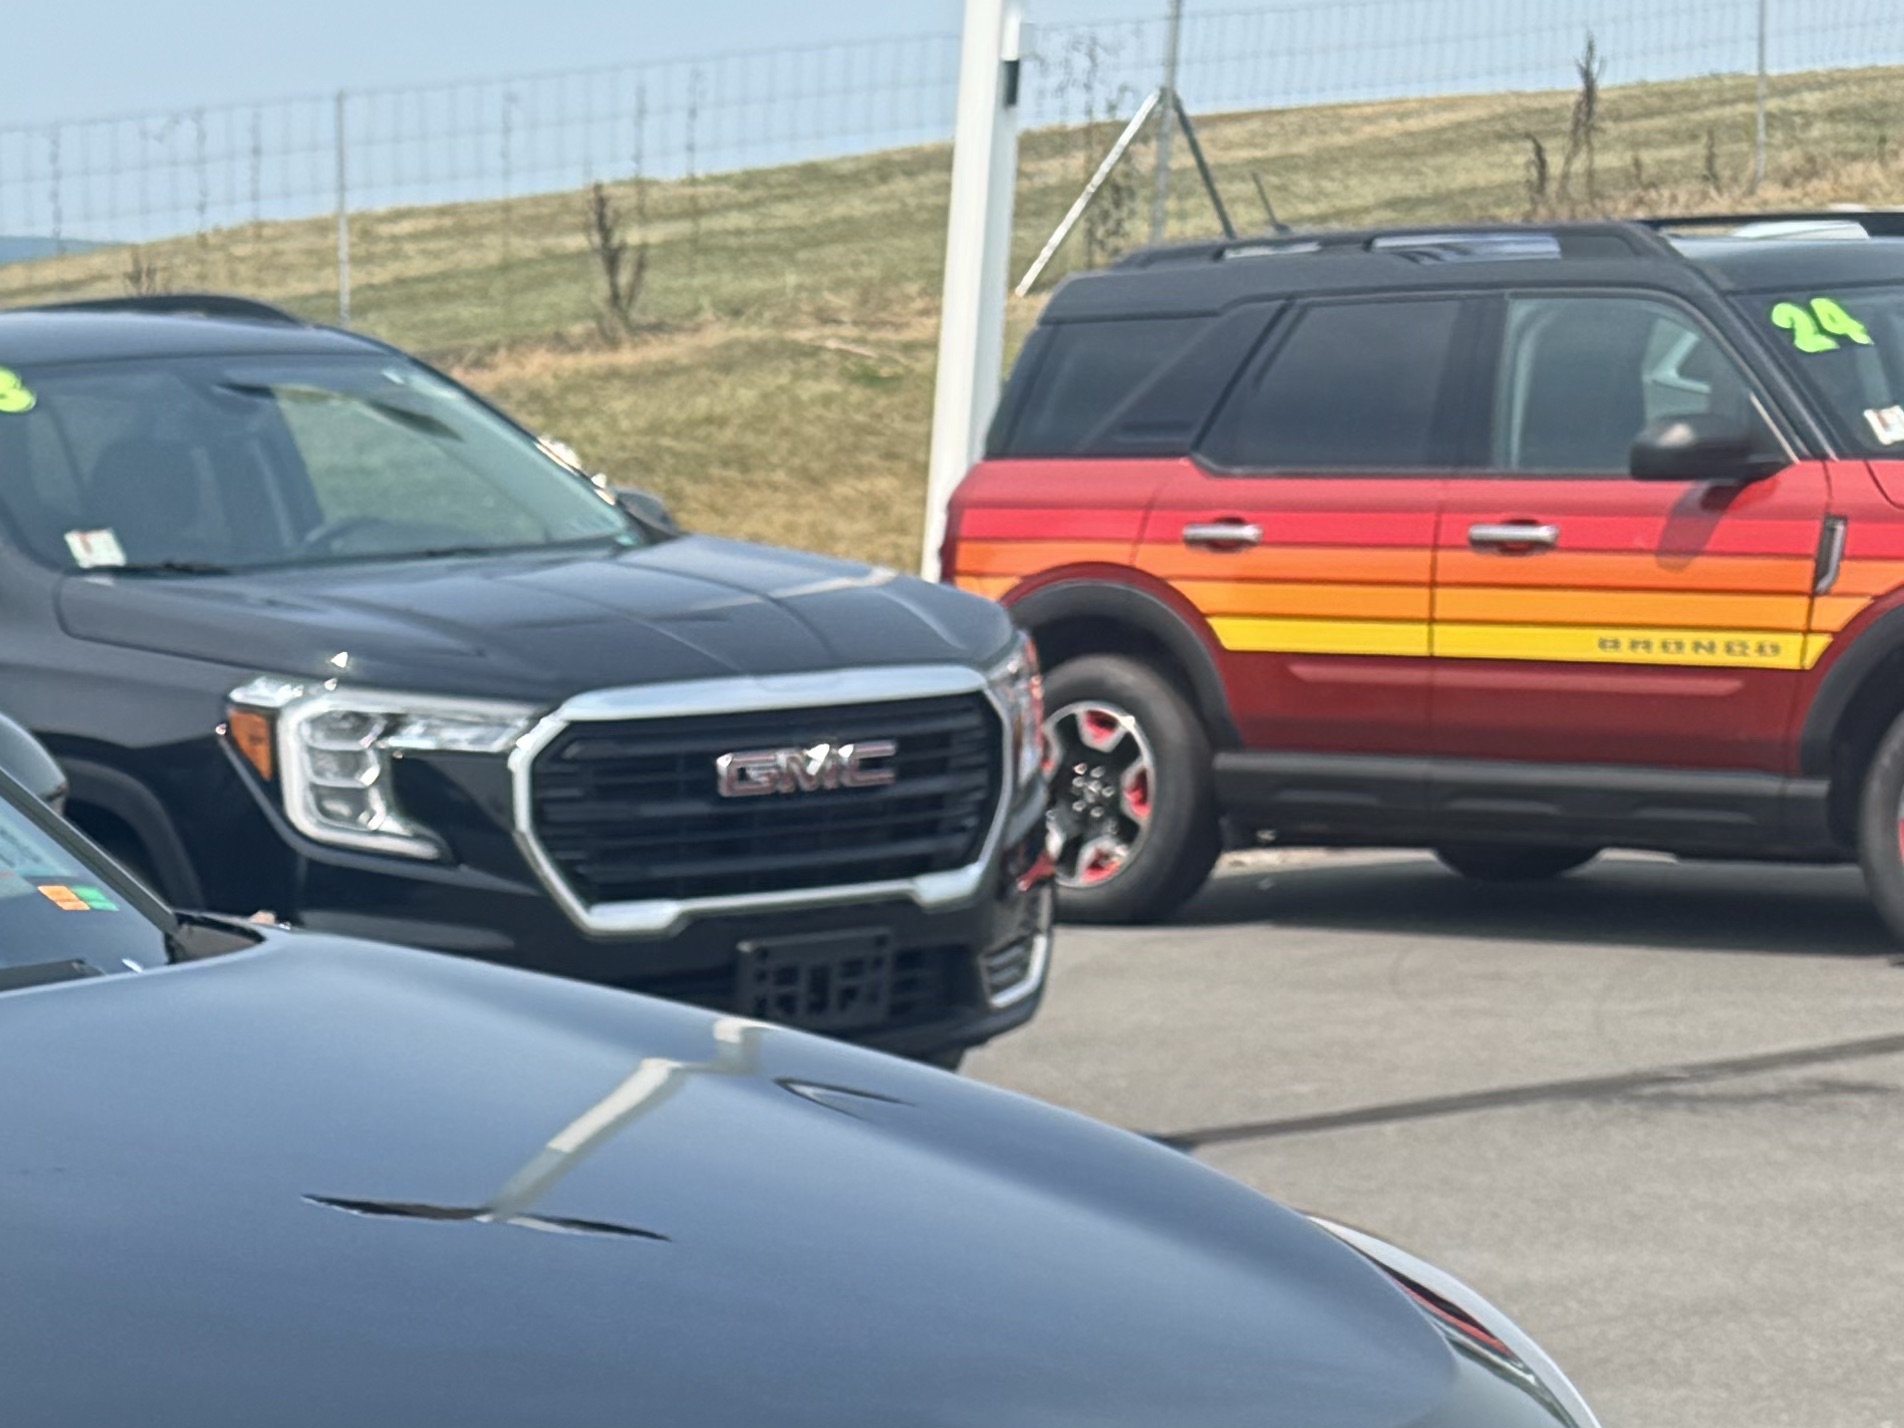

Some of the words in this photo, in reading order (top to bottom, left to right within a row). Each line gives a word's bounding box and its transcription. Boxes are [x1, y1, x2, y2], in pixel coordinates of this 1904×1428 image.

[1771, 297, 1875, 353] 24
[1597, 636, 1782, 658] BRONCO
[716, 739, 898, 798] GMC
